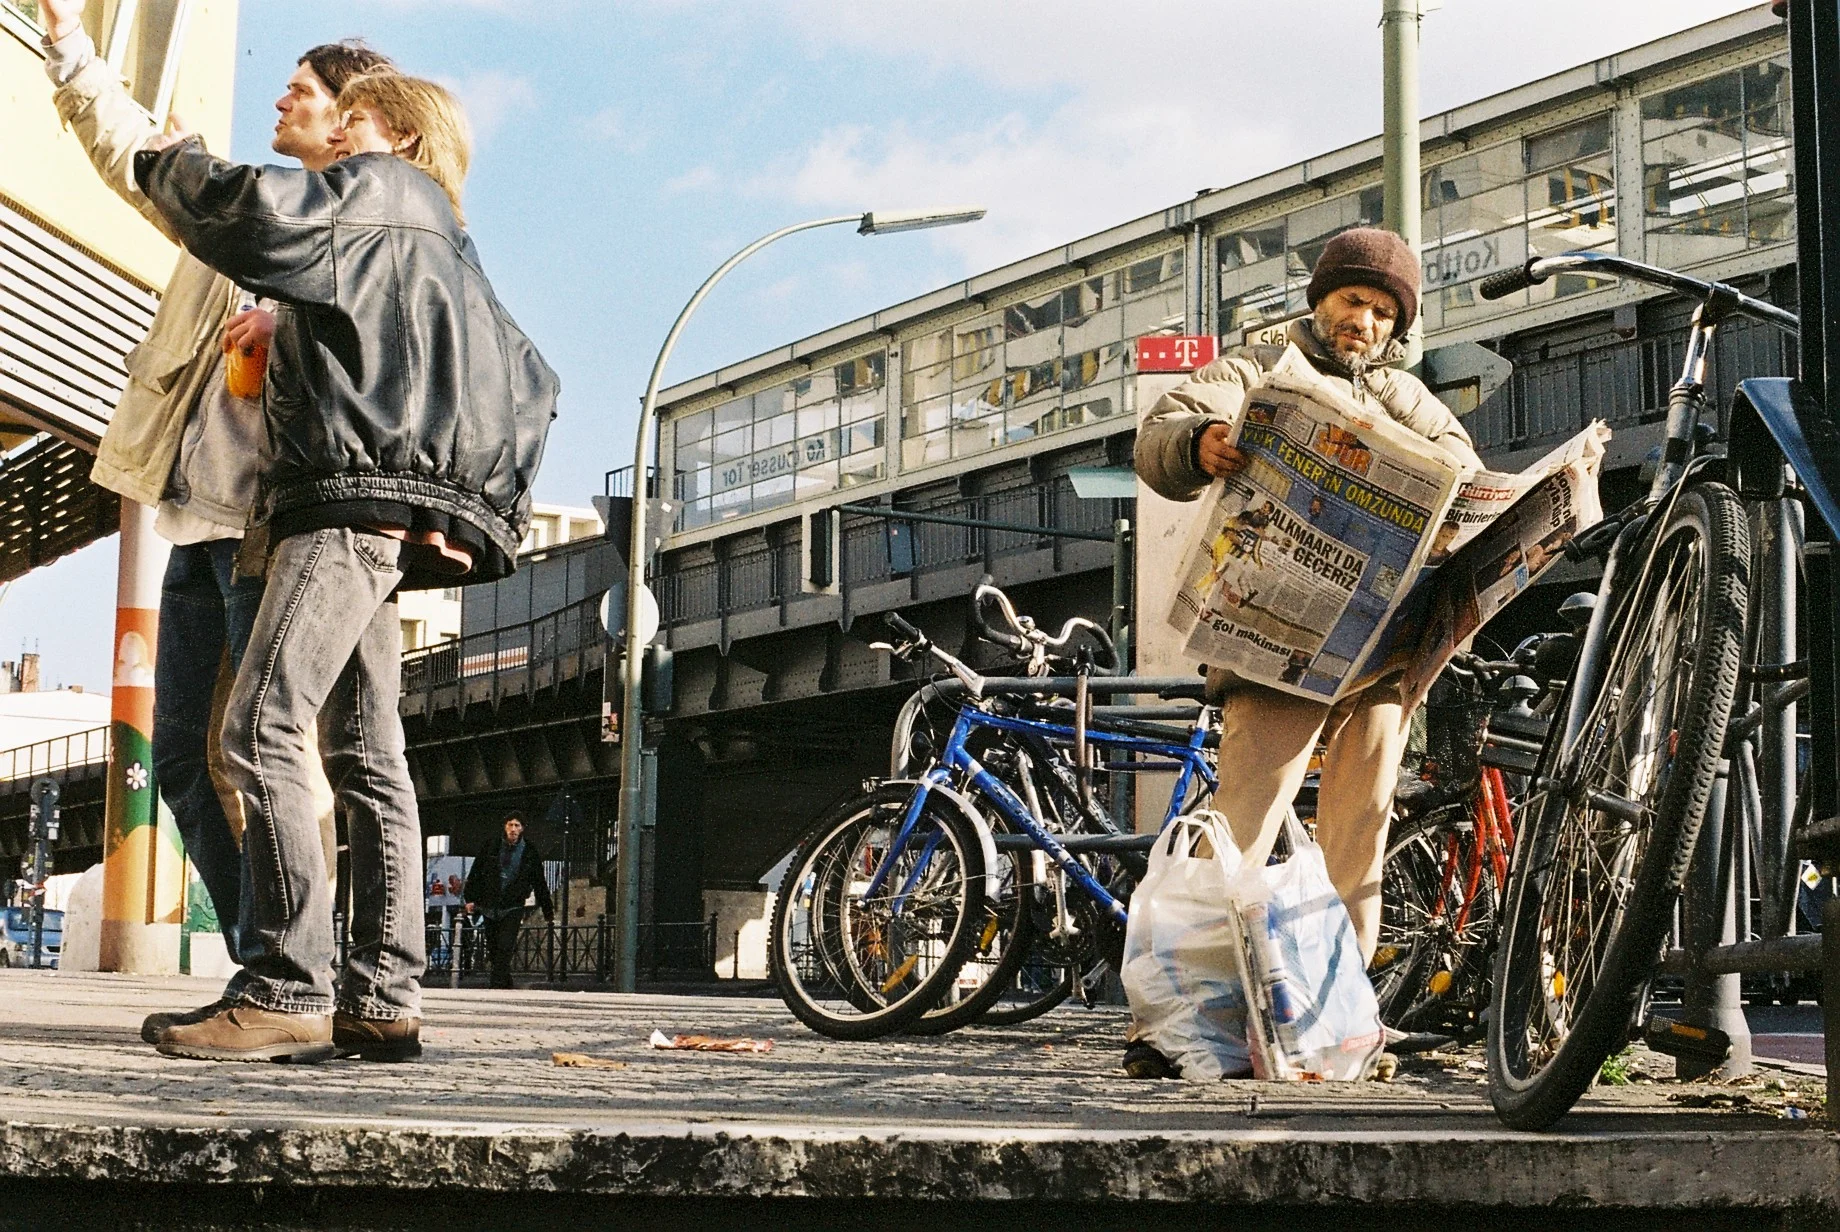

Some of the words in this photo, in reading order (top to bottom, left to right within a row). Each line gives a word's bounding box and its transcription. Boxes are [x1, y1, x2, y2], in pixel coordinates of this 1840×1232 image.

[1175, 339, 1199, 367] T
[1344, 483, 1426, 534] OMZUNDA
[1341, 553, 1364, 577] DA
[1211, 618, 1236, 635] gol
[1236, 626, 1292, 657] makinası
